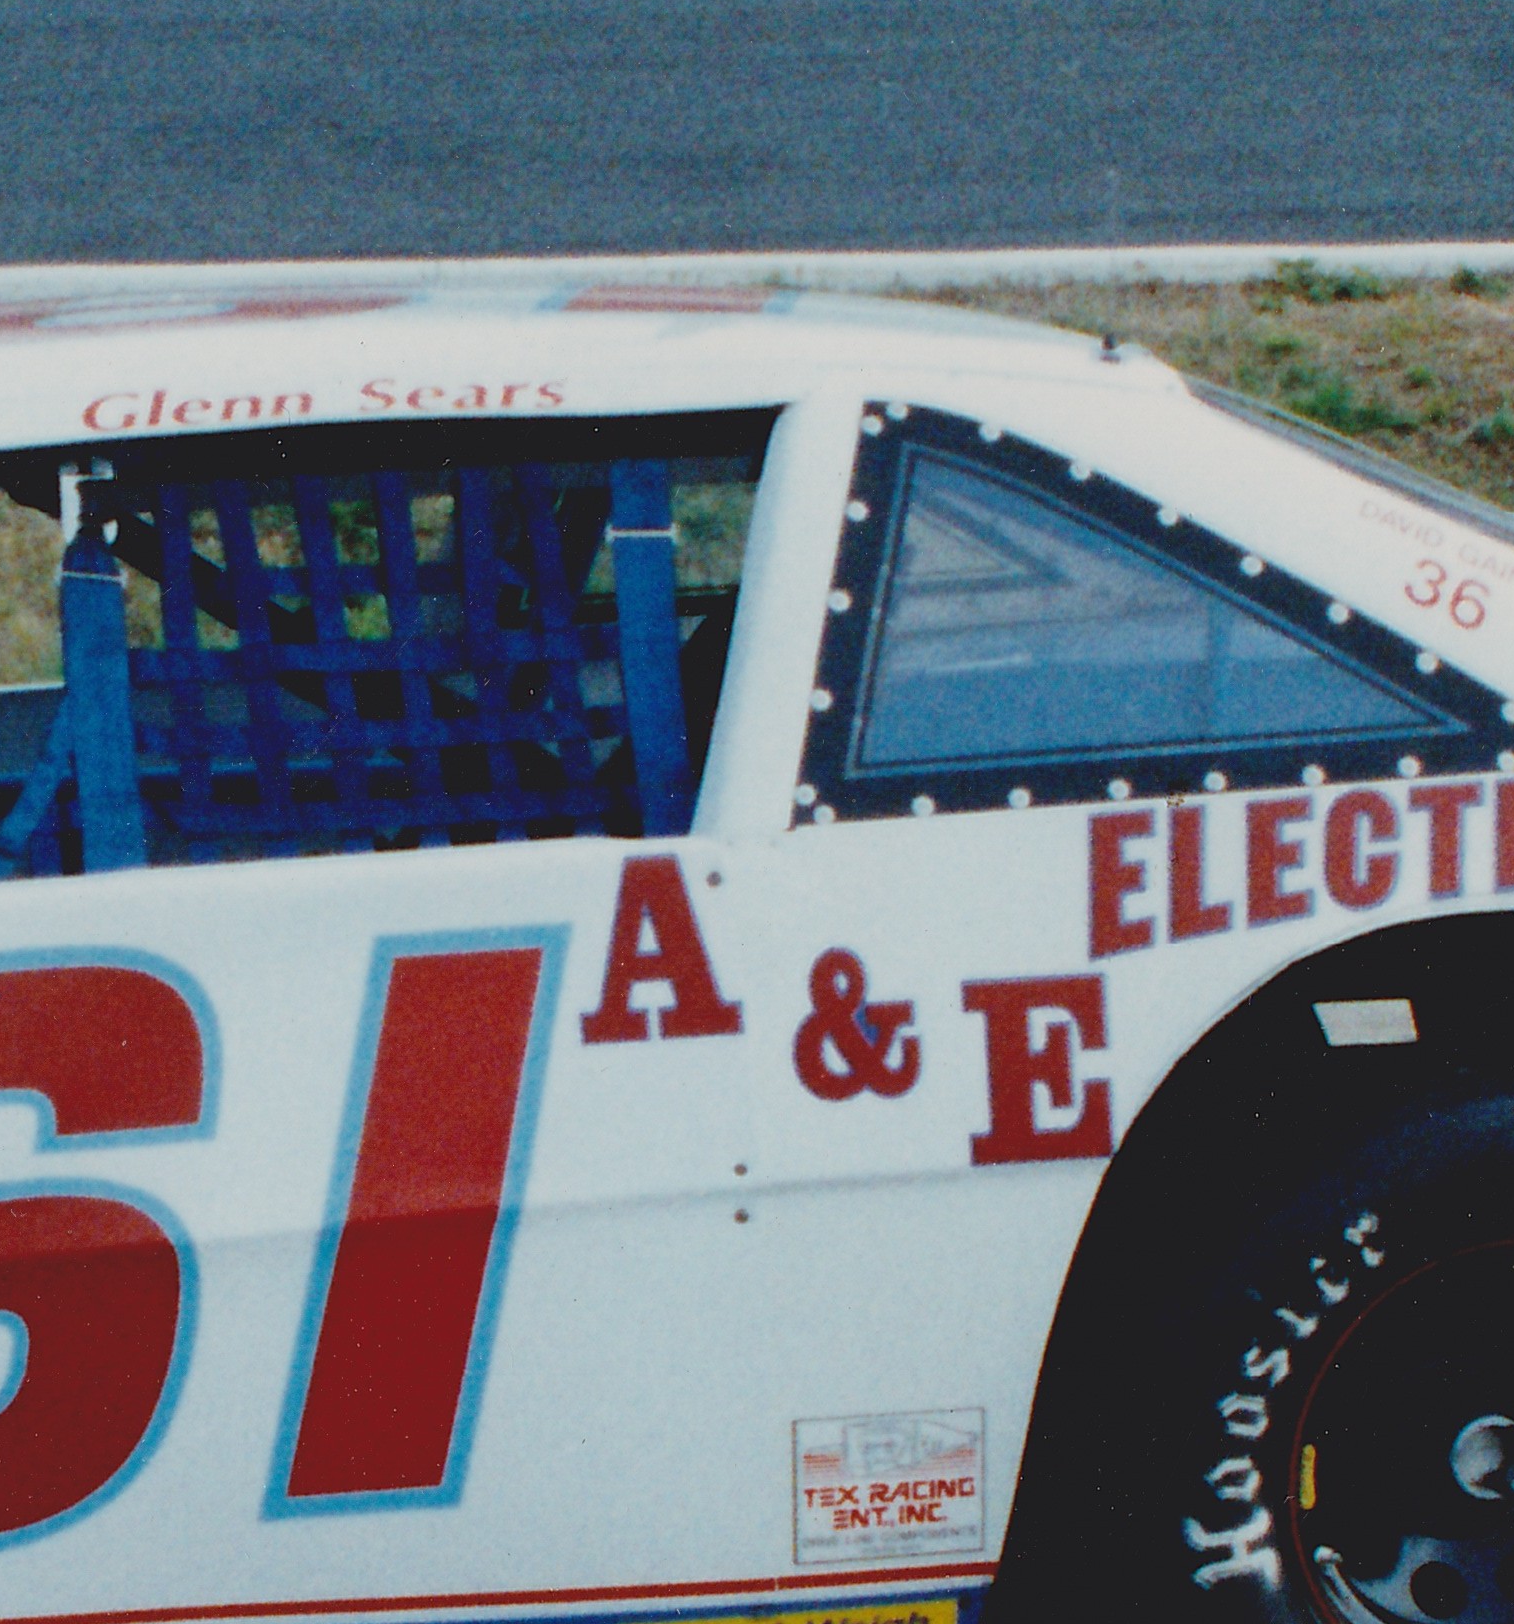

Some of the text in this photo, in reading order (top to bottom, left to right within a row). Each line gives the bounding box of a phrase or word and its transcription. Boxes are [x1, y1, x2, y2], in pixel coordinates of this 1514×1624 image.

[81, 379, 564, 432] Glenn Sears
[1404, 559, 1491, 630] 36
[581, 853, 743, 1044] A
[794, 948, 920, 1101] &
[962, 974, 1113, 1166] E
[803, 1477, 976, 1509] TEX RACING
